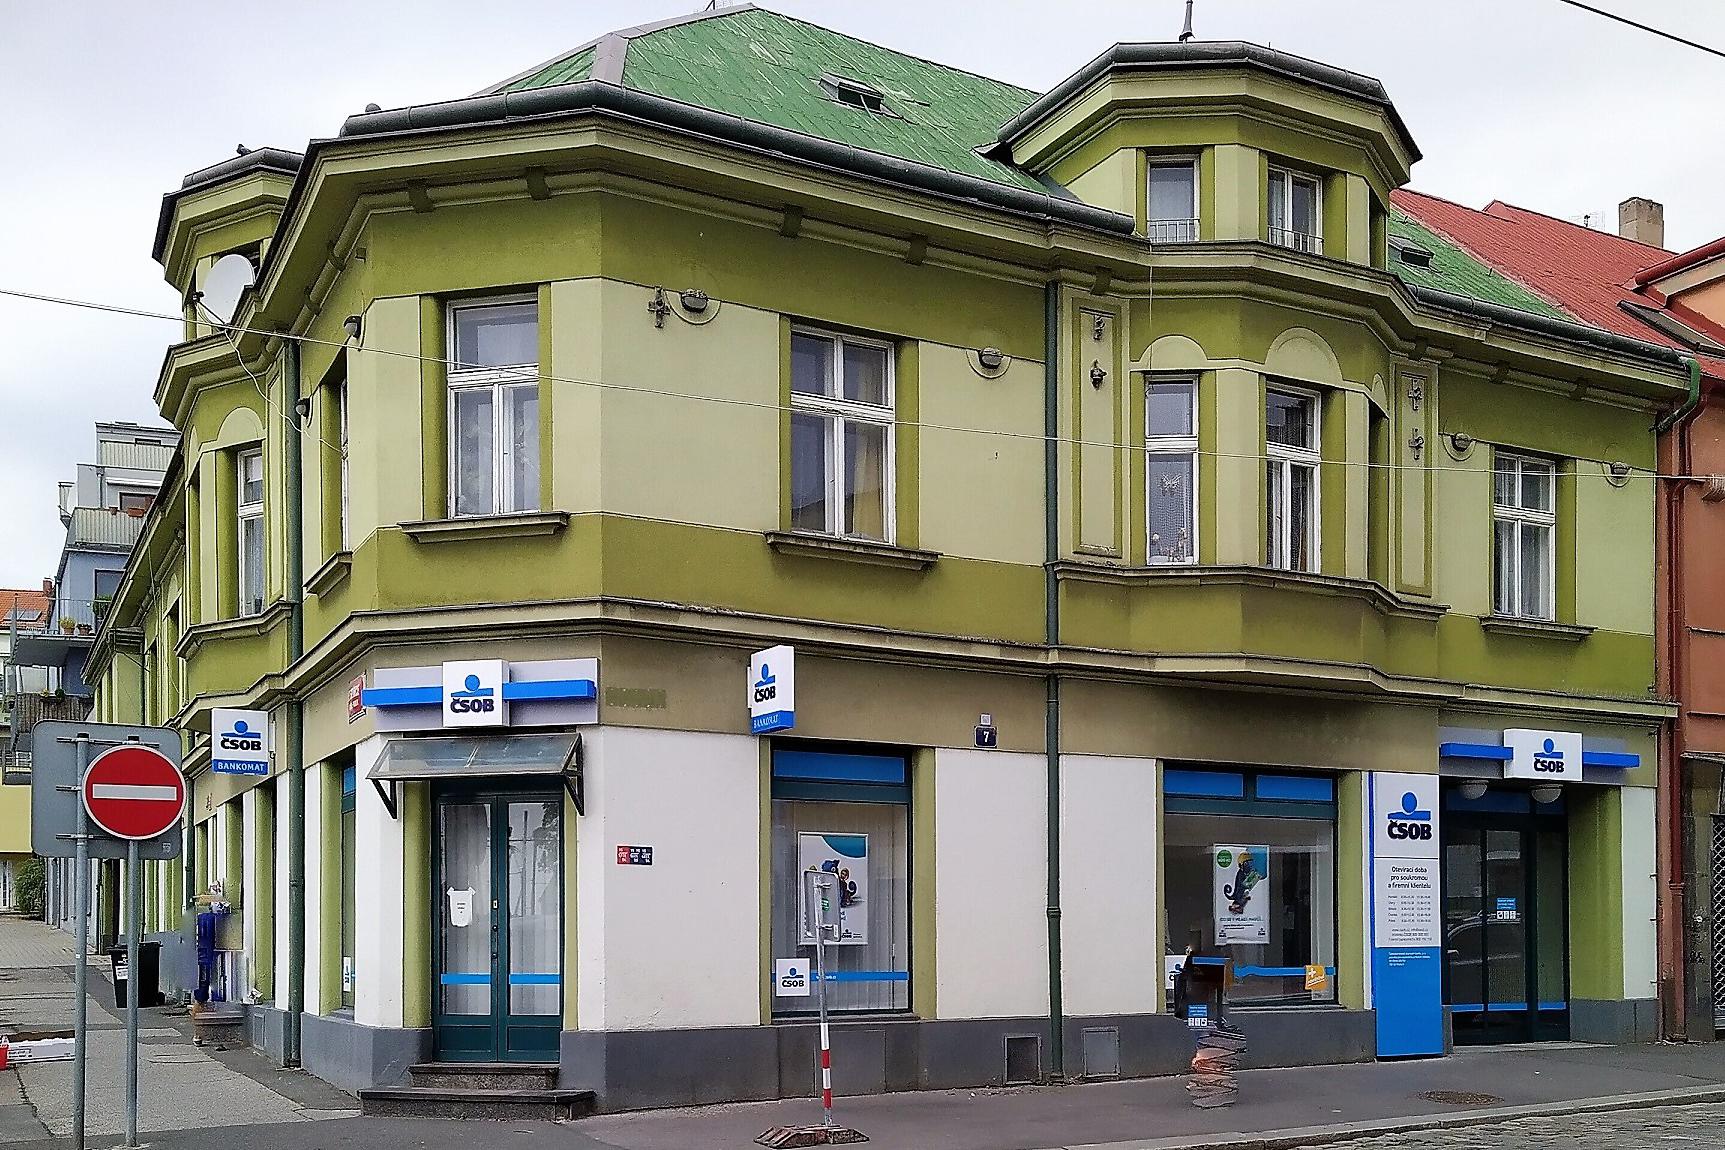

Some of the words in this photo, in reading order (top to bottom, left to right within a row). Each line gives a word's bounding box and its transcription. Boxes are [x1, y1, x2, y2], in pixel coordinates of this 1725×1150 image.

[754, 686, 776, 703] ČSOB
[450, 697, 495, 713] ČSOB
[221, 737, 262, 751] ČSOB
[983, 730, 990, 743] 7
[217, 761, 265, 772] BANKOMAT
[1533, 758, 1565, 773] ČSOB
[1387, 820, 1433, 841] ČSOB
